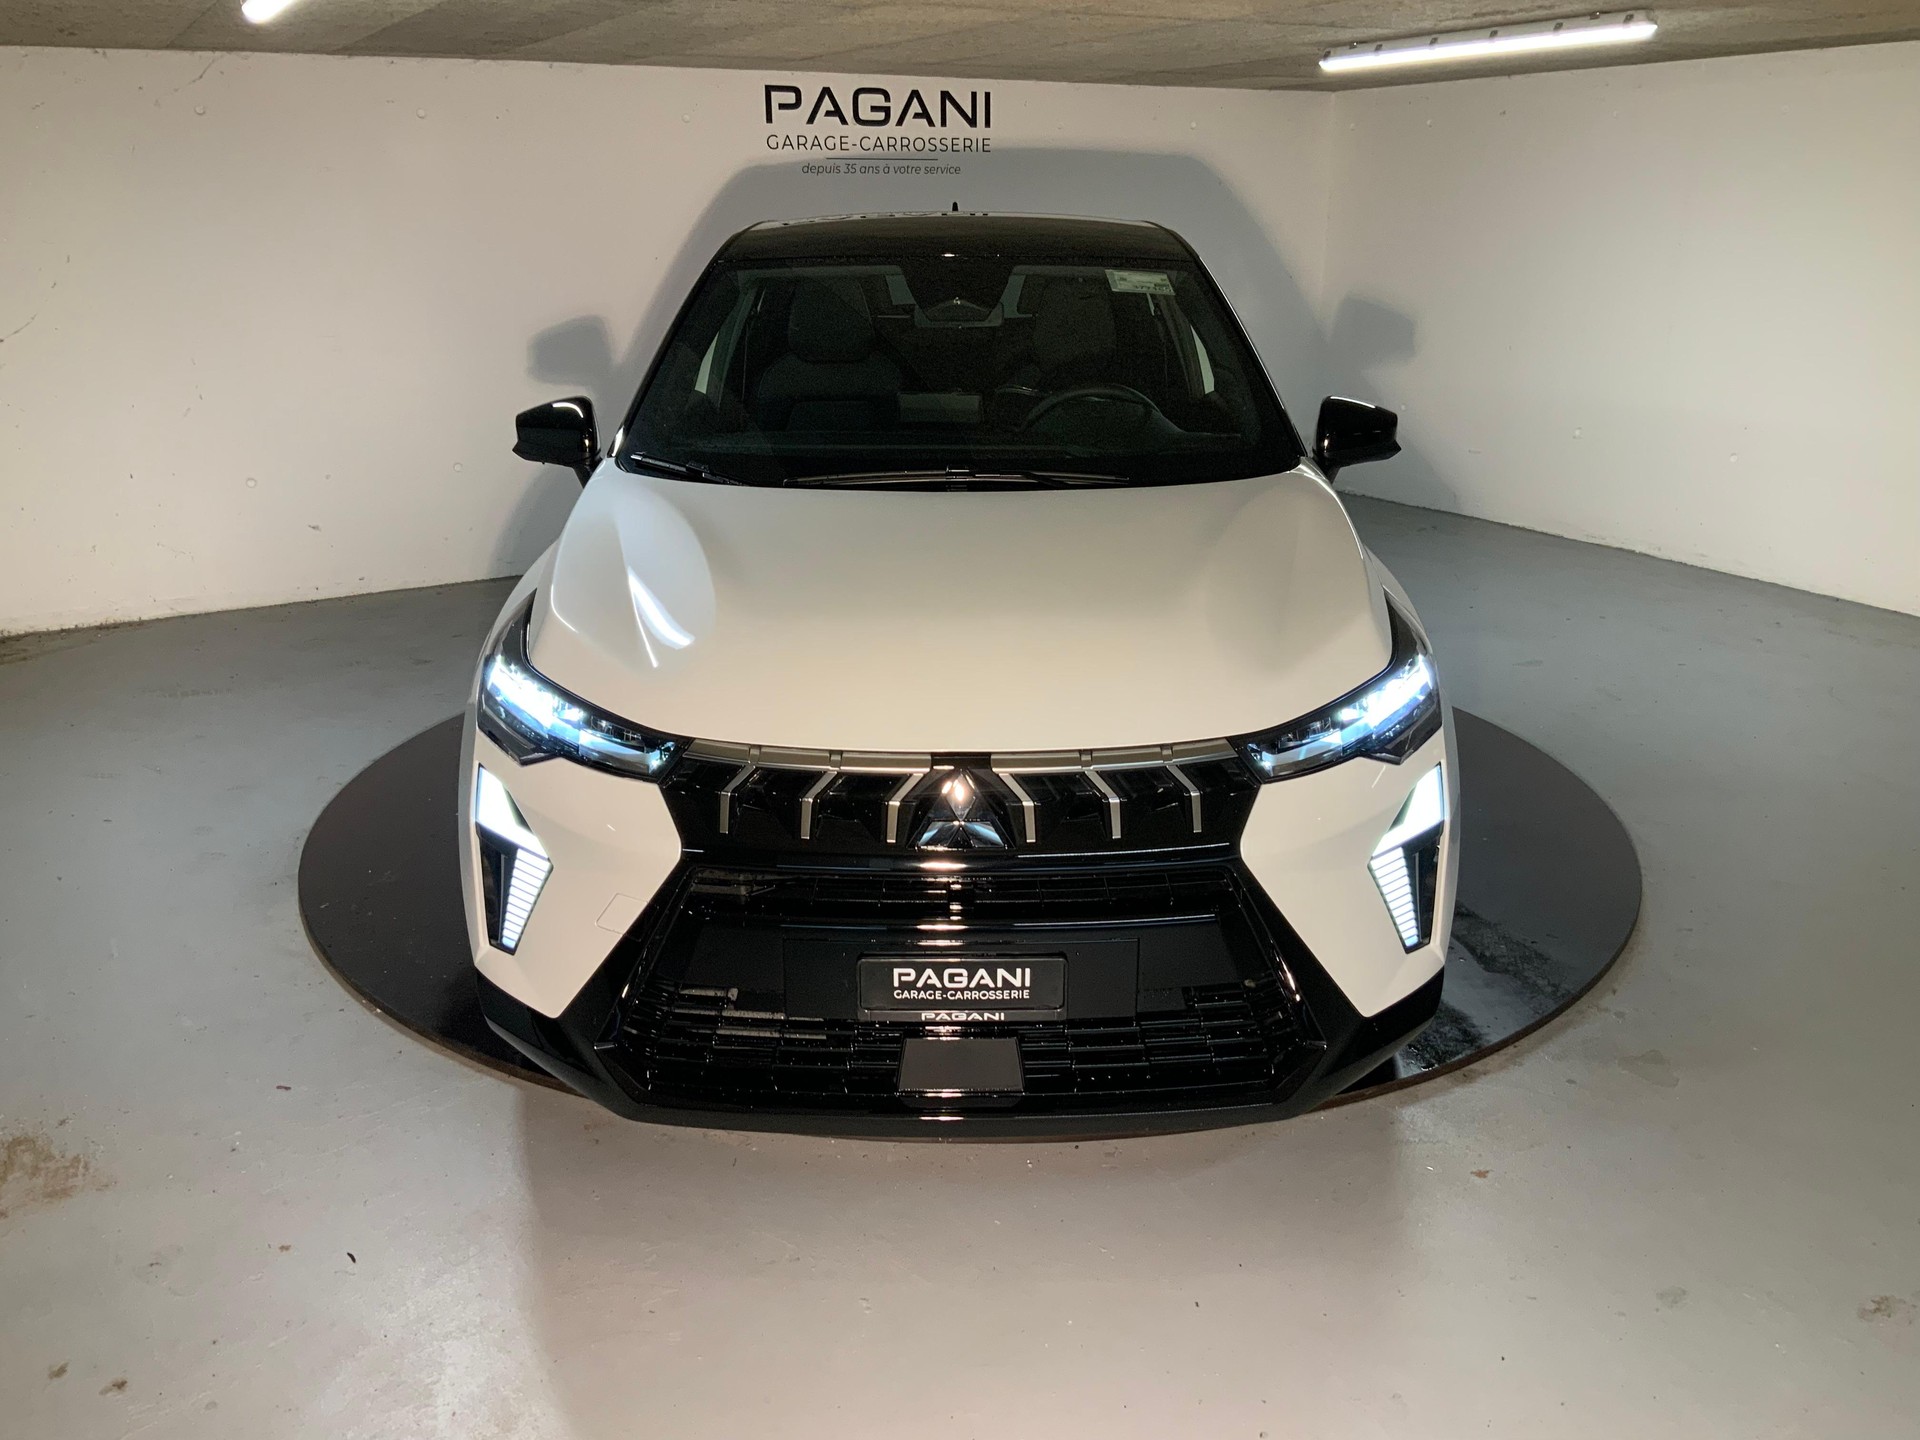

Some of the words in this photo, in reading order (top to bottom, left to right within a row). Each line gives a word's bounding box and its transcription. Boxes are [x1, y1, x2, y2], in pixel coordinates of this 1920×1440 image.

[764, 84, 992, 129] PAGANI
[766, 134, 992, 153] GARAGE-CARROSSERIE
[801, 163, 841, 176] depuis
[843, 163, 857, 174] 35
[859, 165, 880, 175] ans
[882, 163, 890, 175] à
[893, 164, 922, 175] votre
[923, 163, 962, 175] service
[893, 967, 1031, 989] PAGANI
[893, 989, 1030, 1000] GARAGE-CARROSSERIE
[921, 1012, 1005, 1021] PAGANI
